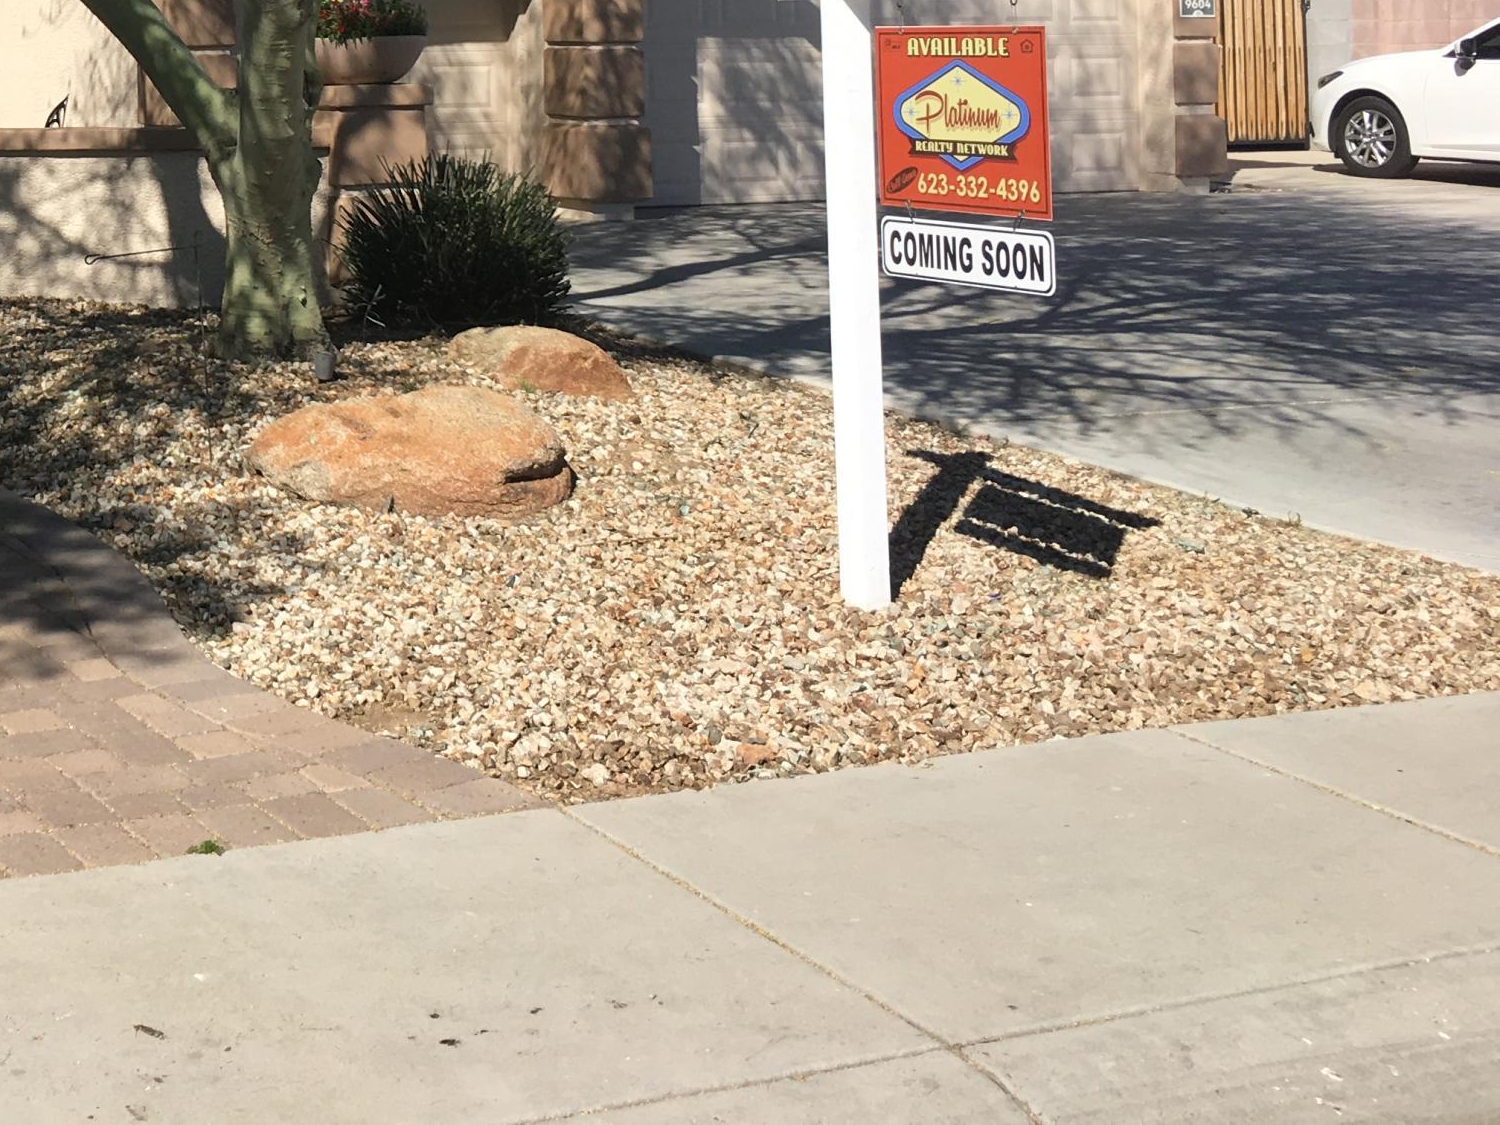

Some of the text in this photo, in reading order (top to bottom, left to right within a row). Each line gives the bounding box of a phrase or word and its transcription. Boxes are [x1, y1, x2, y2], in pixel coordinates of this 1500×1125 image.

[907, 37, 1010, 57] AVAILABLE
[914, 90, 1002, 133] Platinum
[915, 139, 1009, 157] REALTY NETWORK
[917, 172, 1041, 203] 623-332-4396
[890, 230, 1045, 282] COMING SOON
